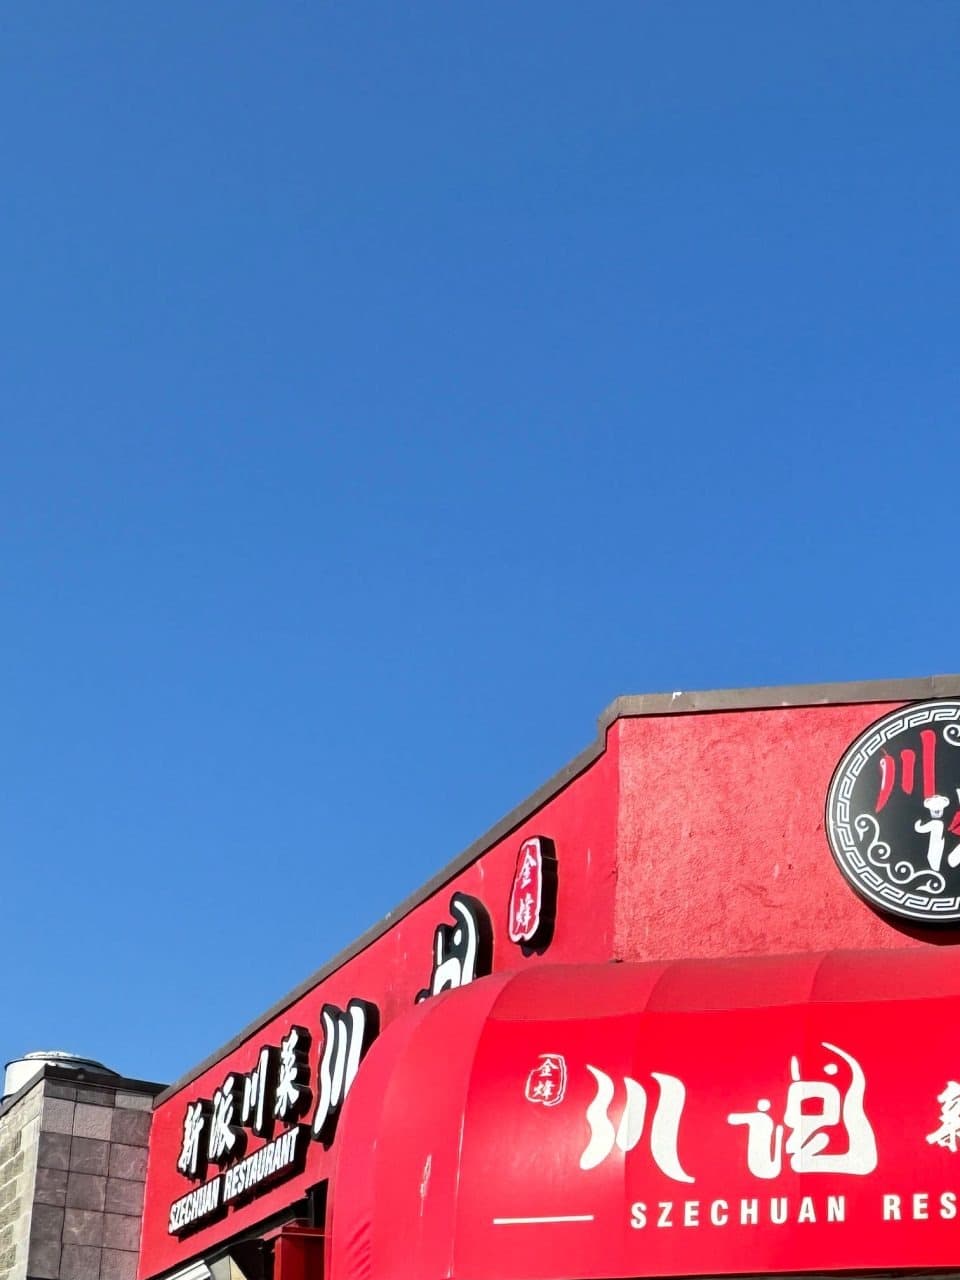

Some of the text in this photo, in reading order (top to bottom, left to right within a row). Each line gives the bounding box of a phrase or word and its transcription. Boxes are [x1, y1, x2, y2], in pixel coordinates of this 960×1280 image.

[169, 1126, 300, 1233] SZECHUAN RESTAURANT
[629, 1197, 847, 1230] SZECHUAN
